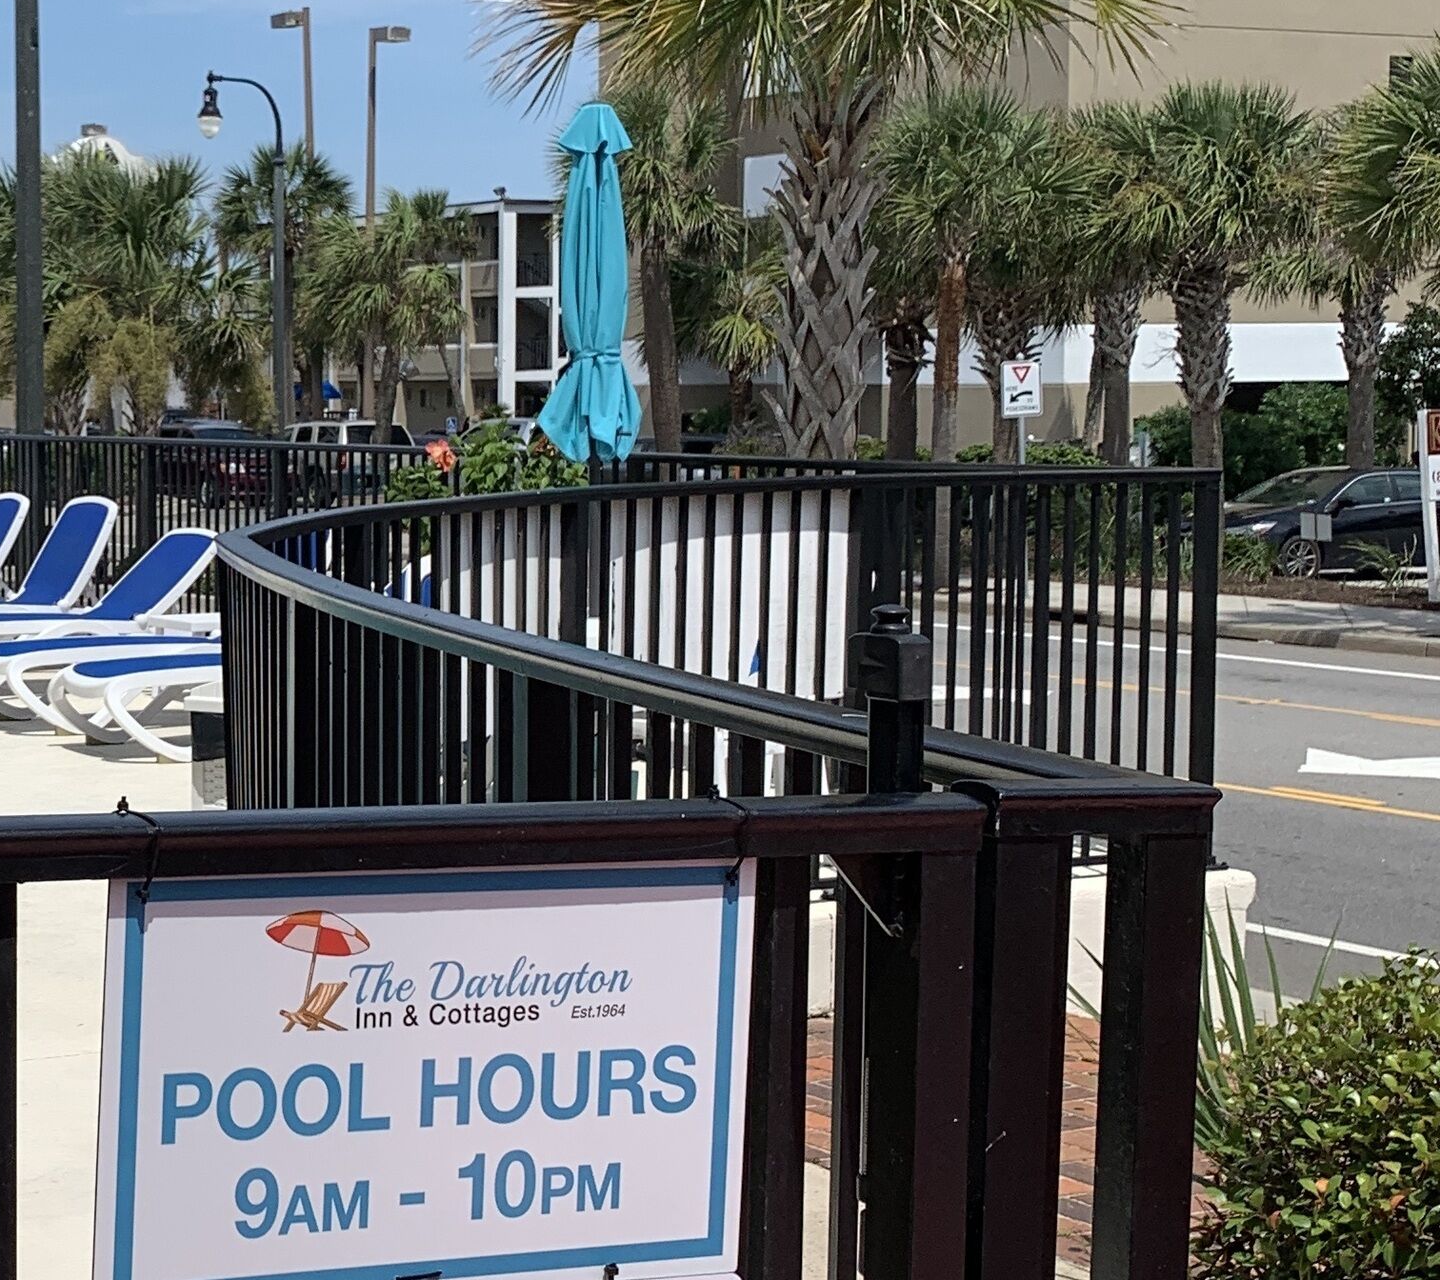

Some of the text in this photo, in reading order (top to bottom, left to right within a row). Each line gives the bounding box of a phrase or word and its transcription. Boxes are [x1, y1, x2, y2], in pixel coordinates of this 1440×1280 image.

[349, 955, 633, 1008] The Darlington
[355, 1002, 540, 1030] Inn & Cottages
[570, 1003, 626, 1019] Est.1964
[161, 1045, 697, 1145] POOL HOURS
[235, 1150, 622, 1240] 9AM - 10PM
